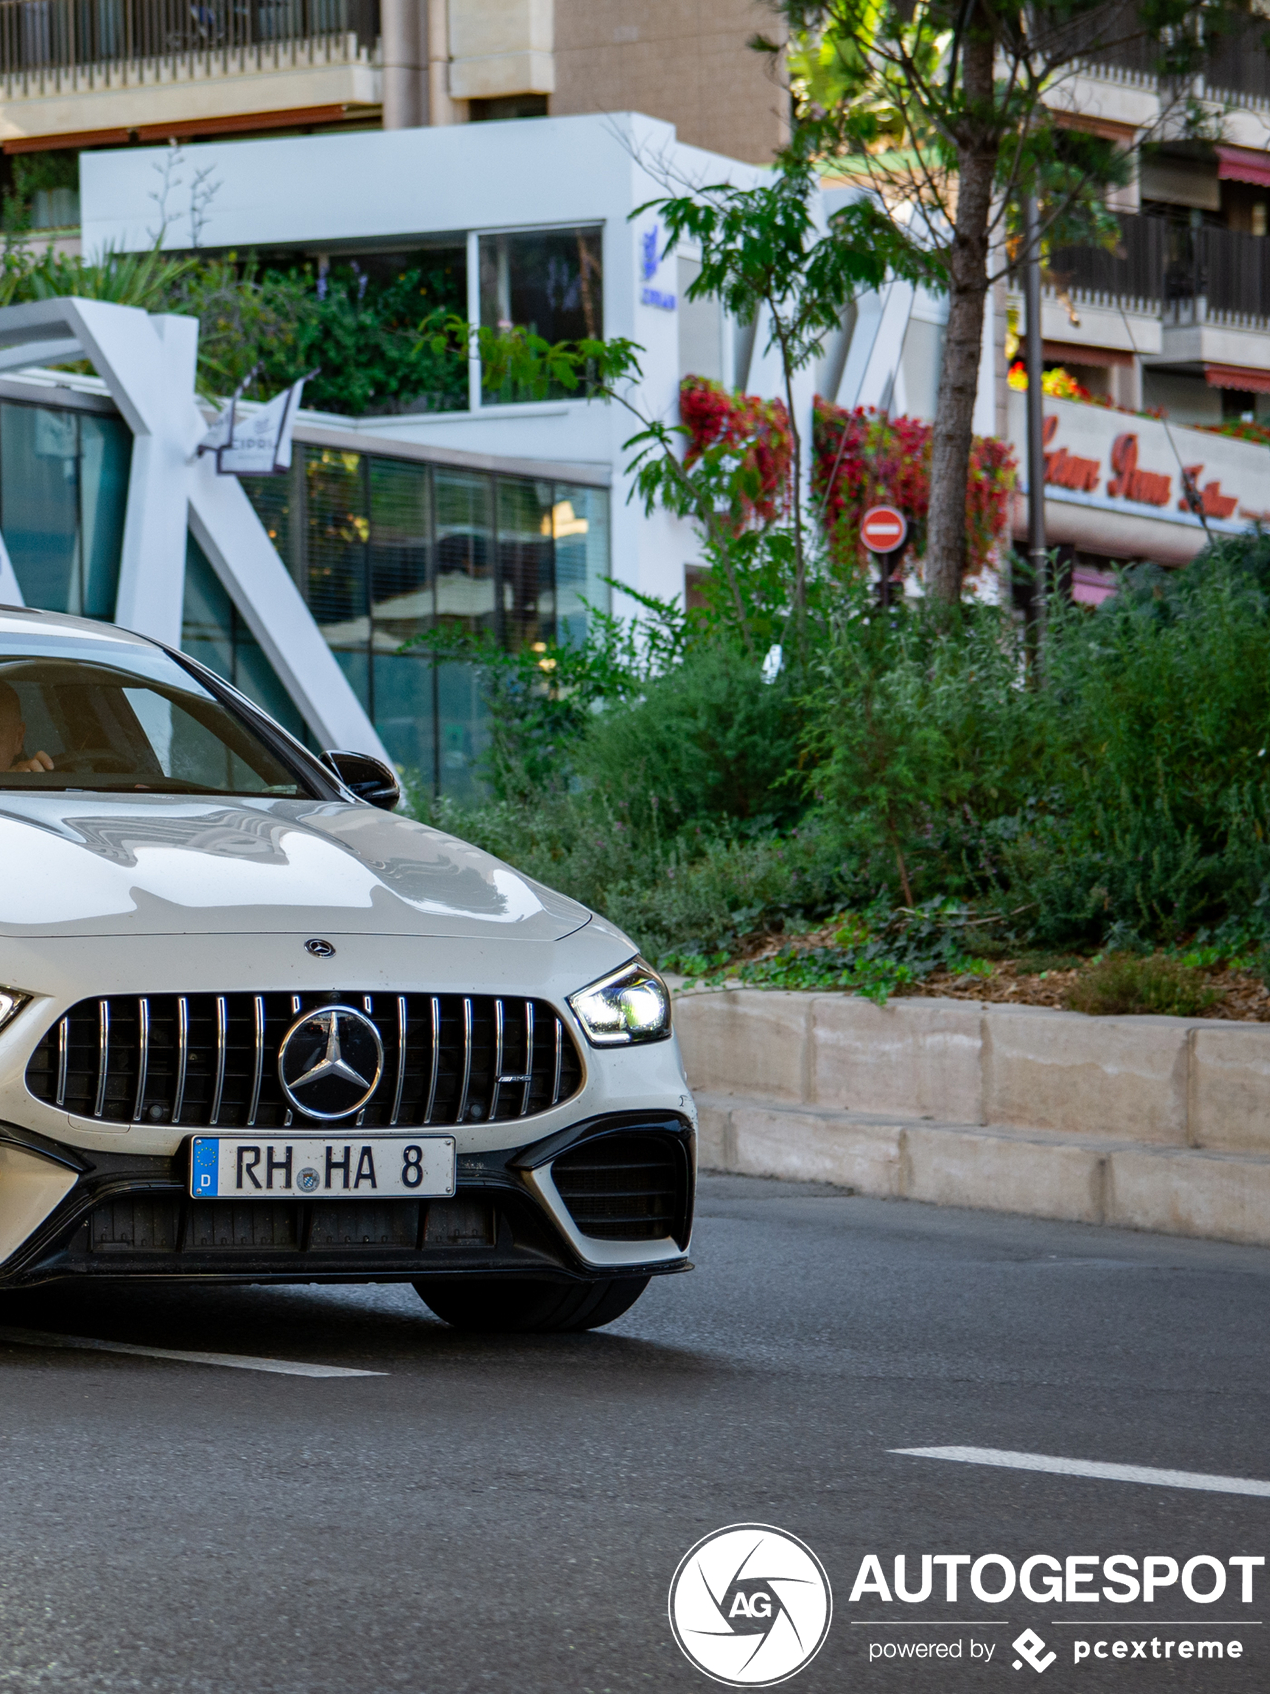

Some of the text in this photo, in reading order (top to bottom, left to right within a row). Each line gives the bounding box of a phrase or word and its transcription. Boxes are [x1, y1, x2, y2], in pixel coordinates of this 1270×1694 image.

[200, 1174, 211, 1187] D
[236, 1146, 293, 1189] RH
[324, 1146, 377, 1189] HA
[401, 1145, 423, 1188] 8
